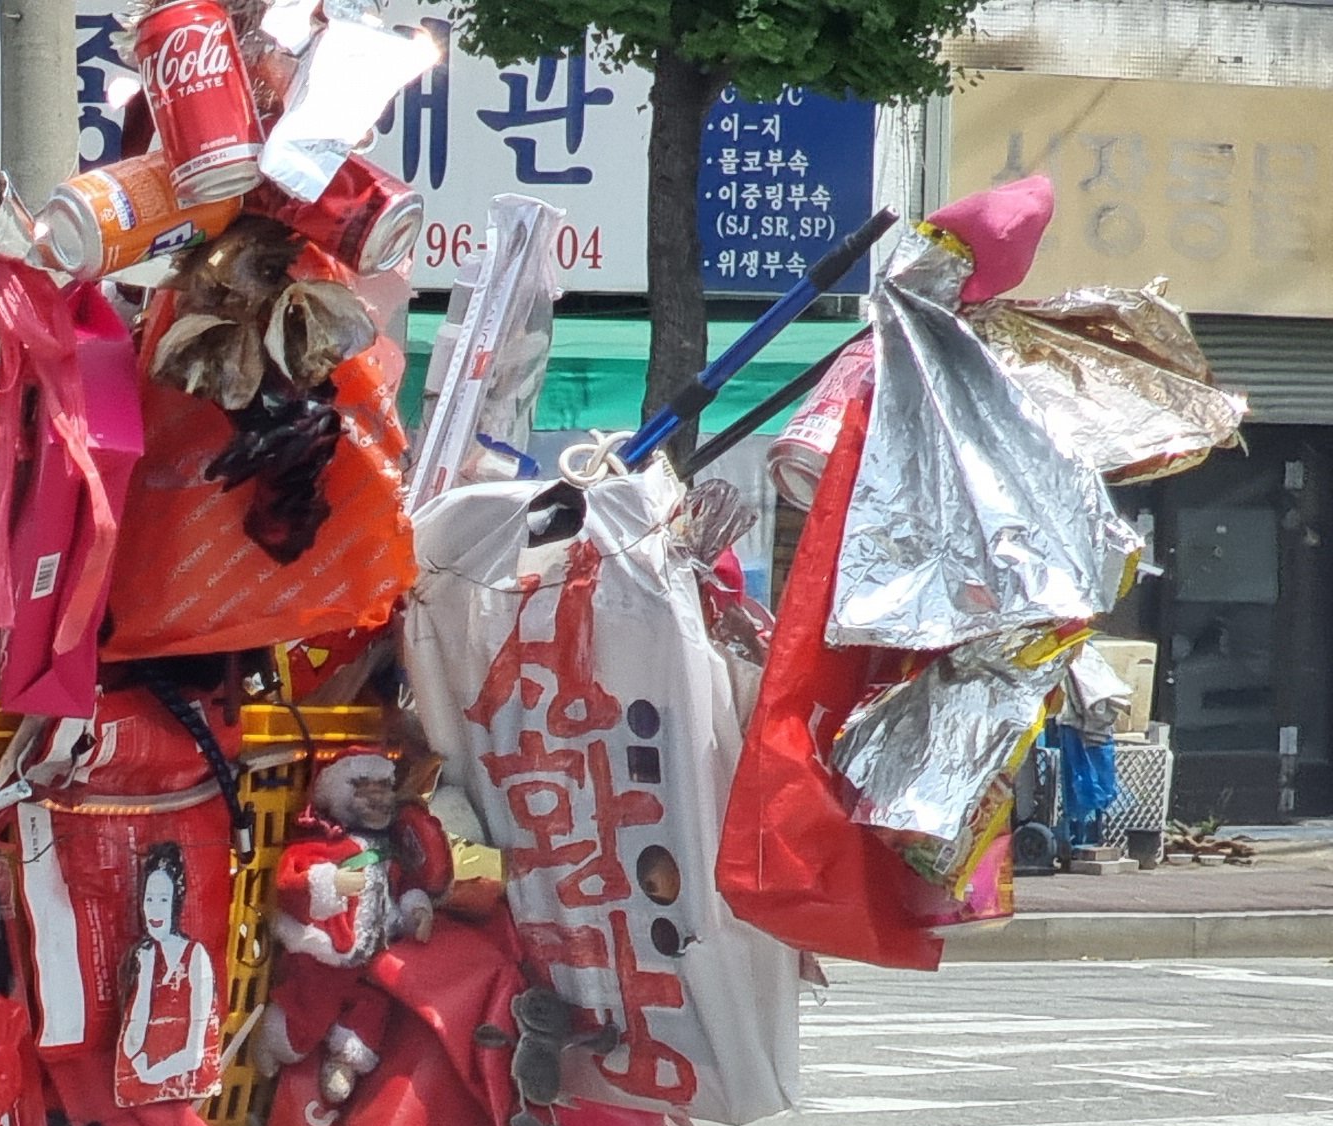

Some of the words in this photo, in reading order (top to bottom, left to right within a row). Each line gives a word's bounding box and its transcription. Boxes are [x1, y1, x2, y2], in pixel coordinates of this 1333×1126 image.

[177, 75, 225, 97] TASTE
[718, 147, 809, 178] 몰코부속
[718, 181, 832, 212] 이중링부속
[716, 249, 808, 279] 위생부속
